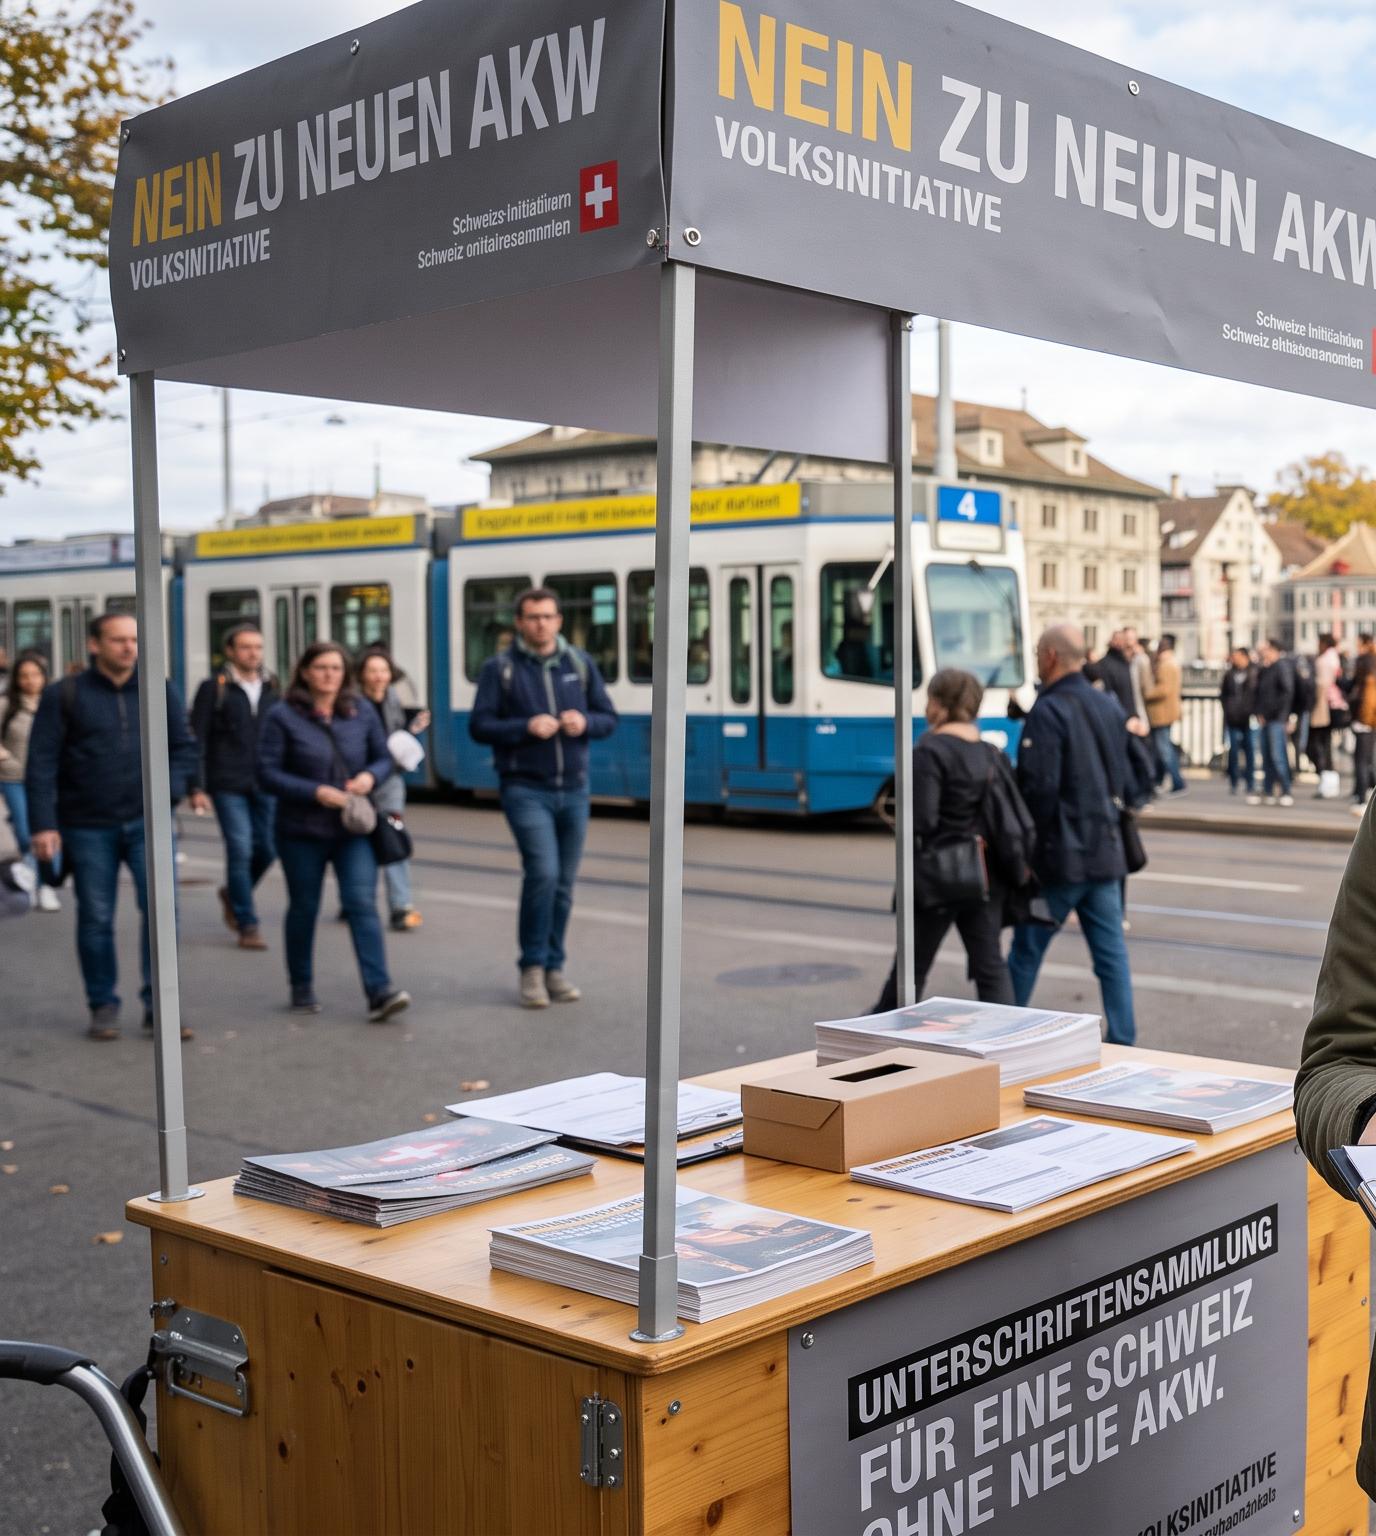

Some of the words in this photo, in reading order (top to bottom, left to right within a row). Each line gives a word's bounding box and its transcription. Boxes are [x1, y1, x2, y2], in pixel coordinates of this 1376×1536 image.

[132, 151, 222, 247] NEIN
[234, 128, 284, 220] ZU
[298, 69, 452, 200] NEUEN
[469, 17, 606, 149] AKW
[714, 115, 1001, 233] VOLKSINITIATIVE
[719, 0, 912, 152] NEIN
[939, 75, 1029, 184] ZU
[1054, 114, 1256, 254] NEUEN
[130, 228, 270, 291] VOLKSINITIATIVE
[418, 243, 464, 269] Schweiz
[1223, 323, 1270, 349] Schweiz
[1256, 310, 1306, 337] Schweize
[957, 491, 977, 521] 4
[858, 1215, 1272, 1424] UNTERSCHRIFTENSAMMLUNG
[860, 1416, 956, 1512] FÜR
[974, 1361, 1072, 1458] EINE
[1086, 1279, 1254, 1402] SCHWEIZ
[1010, 1403, 1120, 1508] NEUE
[1130, 1354, 1225, 1447] AKW.
